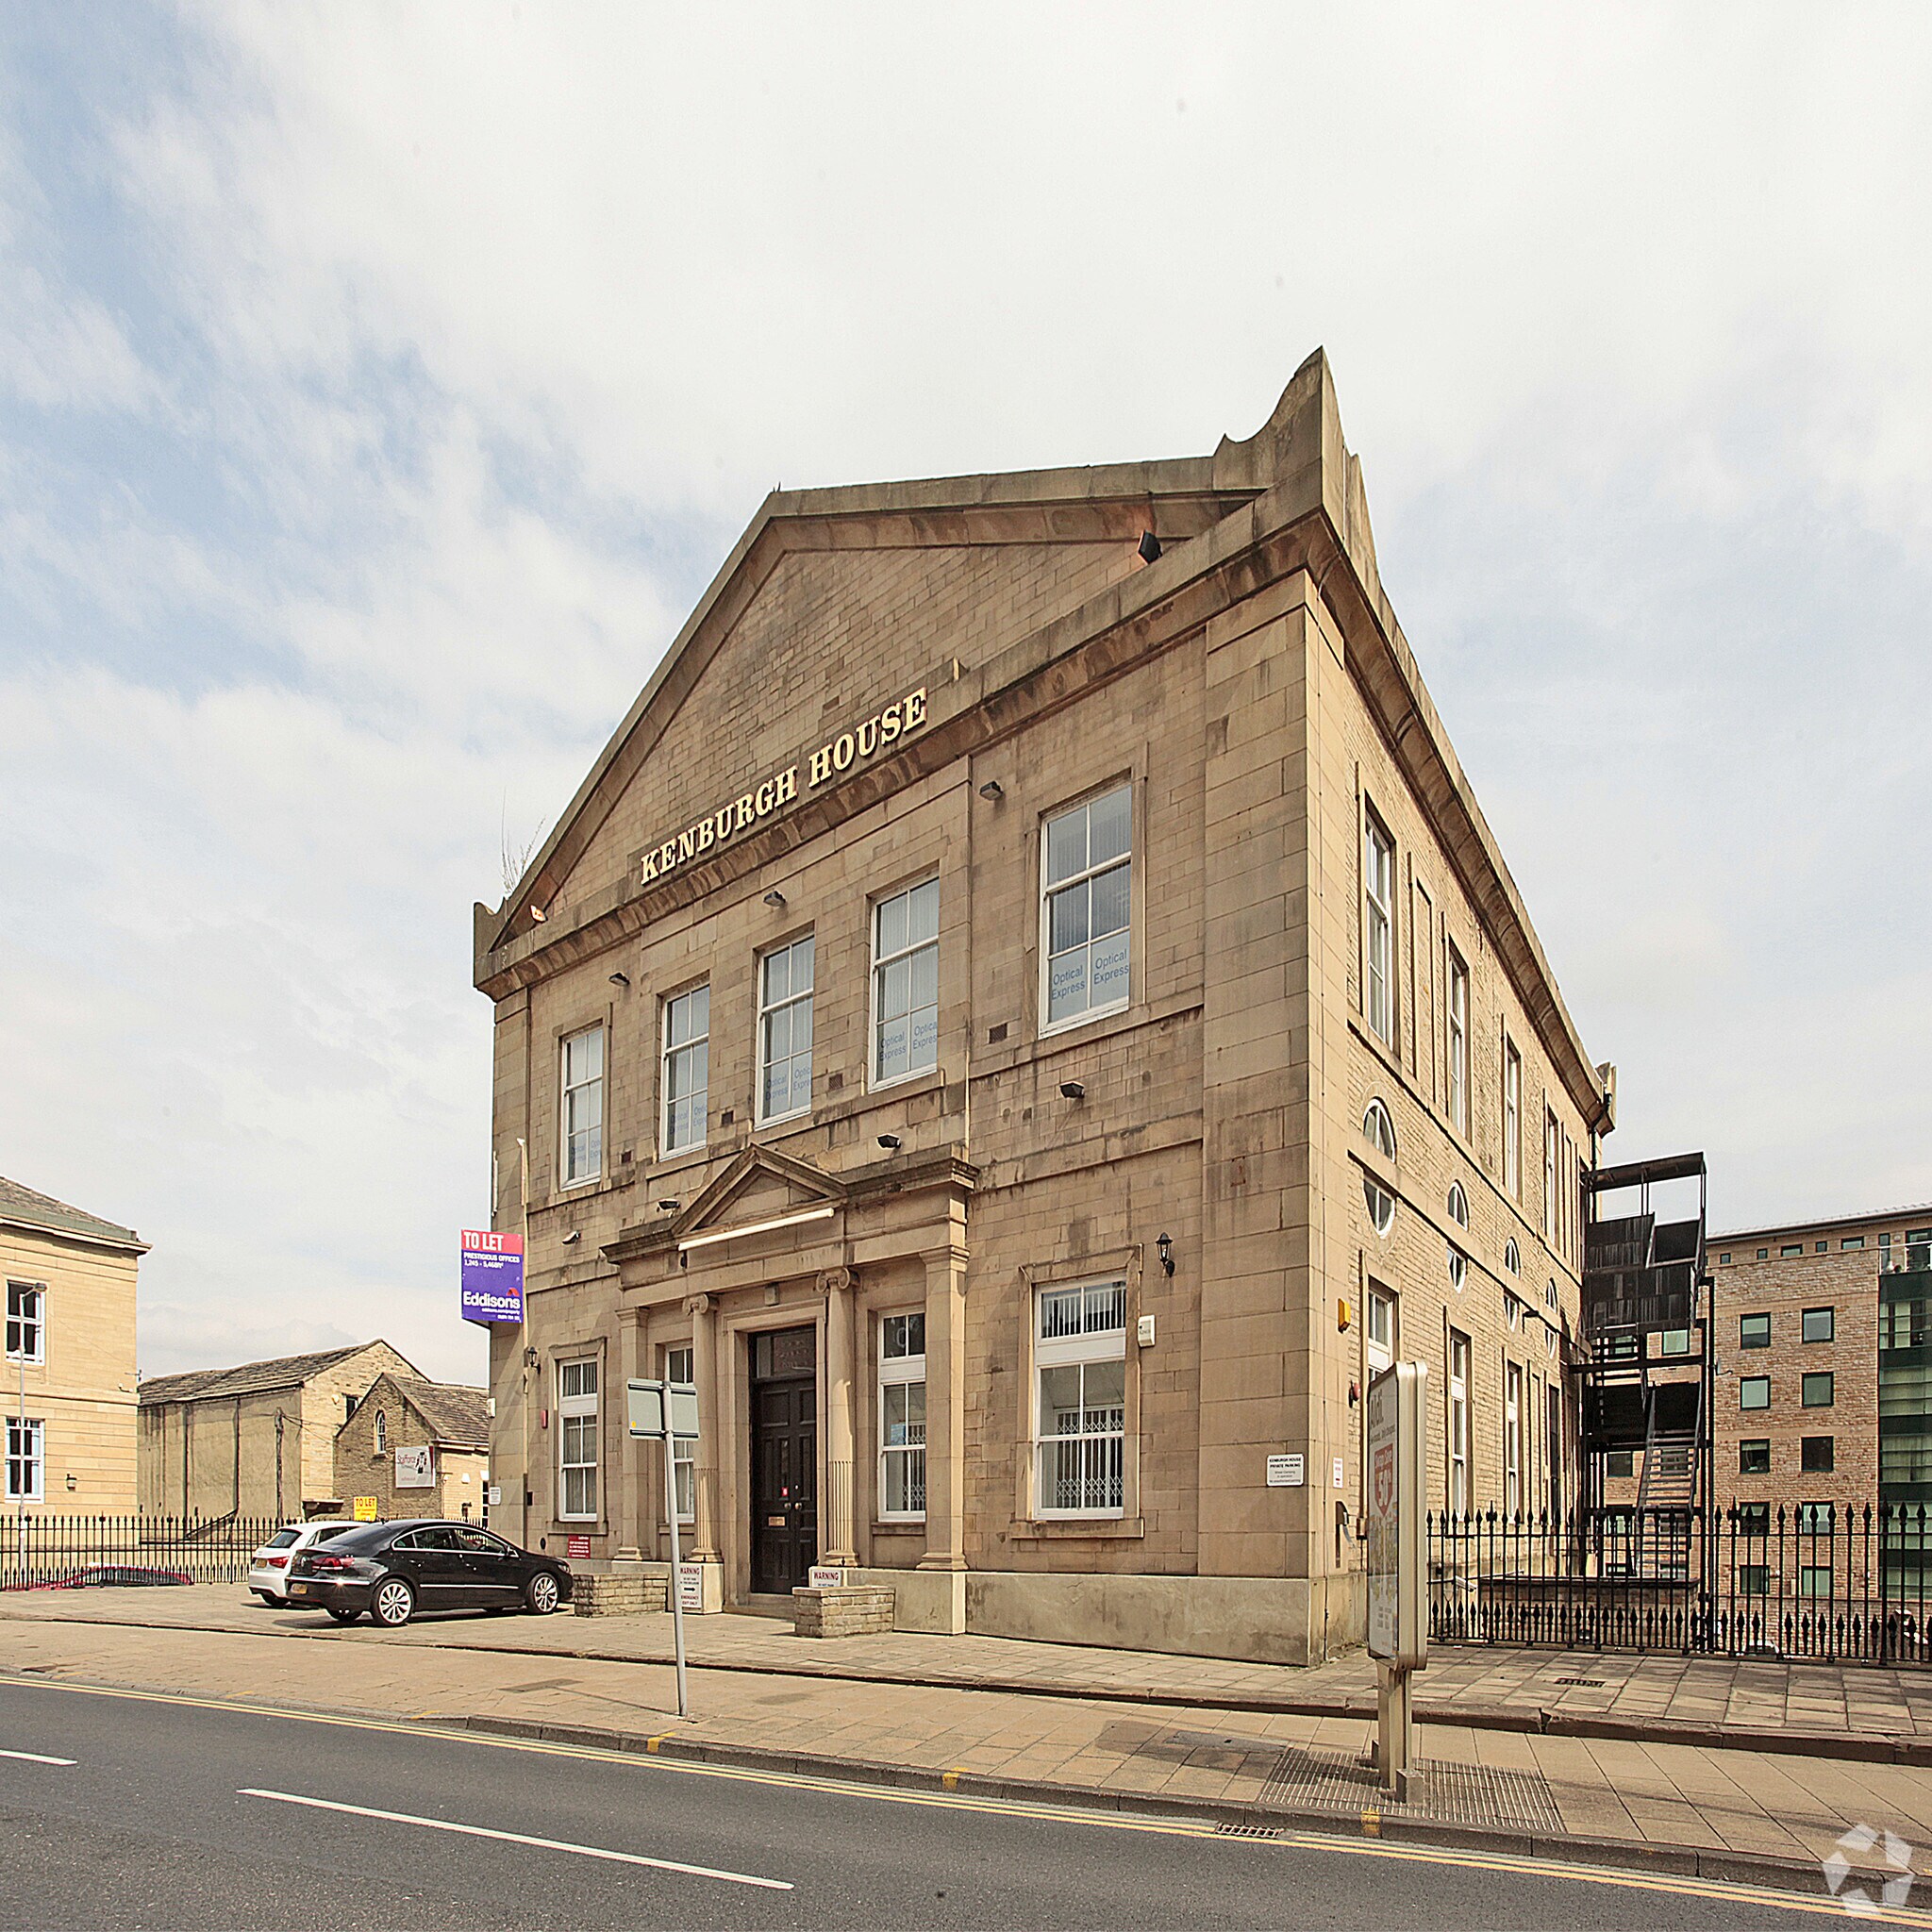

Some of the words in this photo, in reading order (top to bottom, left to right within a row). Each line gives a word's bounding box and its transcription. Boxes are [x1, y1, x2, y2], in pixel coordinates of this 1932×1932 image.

[641, 765, 798, 885] KENBURGH
[808, 687, 927, 788] HOUSE
[1095, 948, 1127, 970] Optical
[1053, 965, 1083, 986] Optical
[1094, 964, 1129, 985] Express
[1052, 980, 1086, 1000] Express
[914, 1022, 937, 1036] Optica
[881, 1031, 905, 1048] Optical
[912, 1034, 937, 1050] Expres
[463, 1232, 480, 1250] TO
[482, 1233, 505, 1251] LET
[463, 1291, 521, 1309] Eddisons
[356, 1497, 363, 1507] TO
[364, 1498, 375, 1507] LET
[680, 1567, 700, 1575] WARNING
[814, 1572, 839, 1580] WARNING
